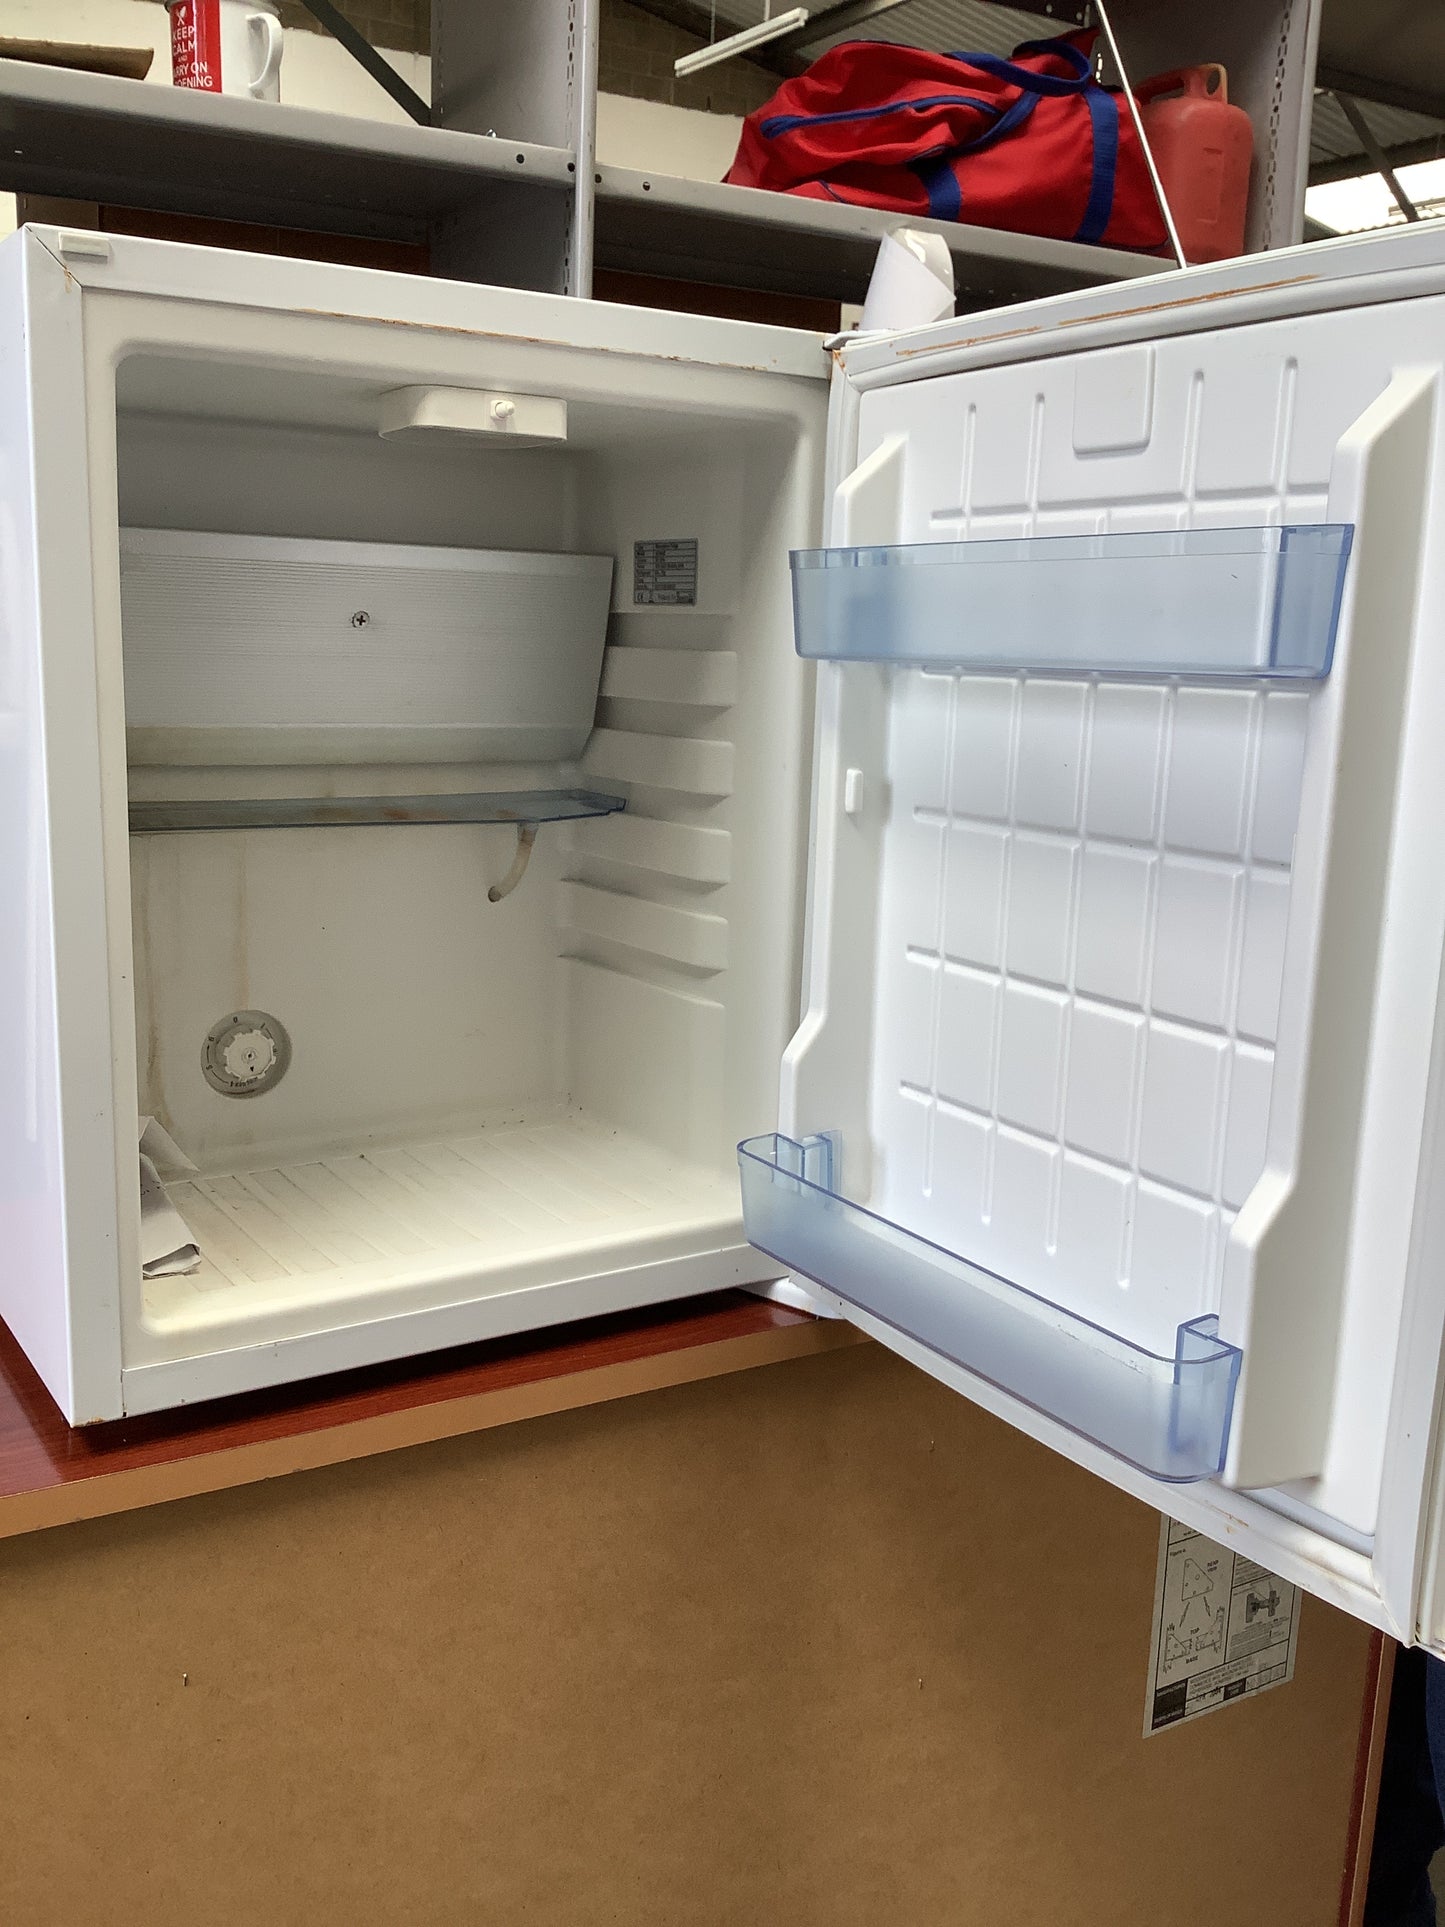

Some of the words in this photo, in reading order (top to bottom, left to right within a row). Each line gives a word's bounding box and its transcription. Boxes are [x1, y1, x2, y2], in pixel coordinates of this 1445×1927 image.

[173, 25, 195, 41] KEEP
[173, 39, 196, 56] CALM
[190, 61, 208, 74] ON
